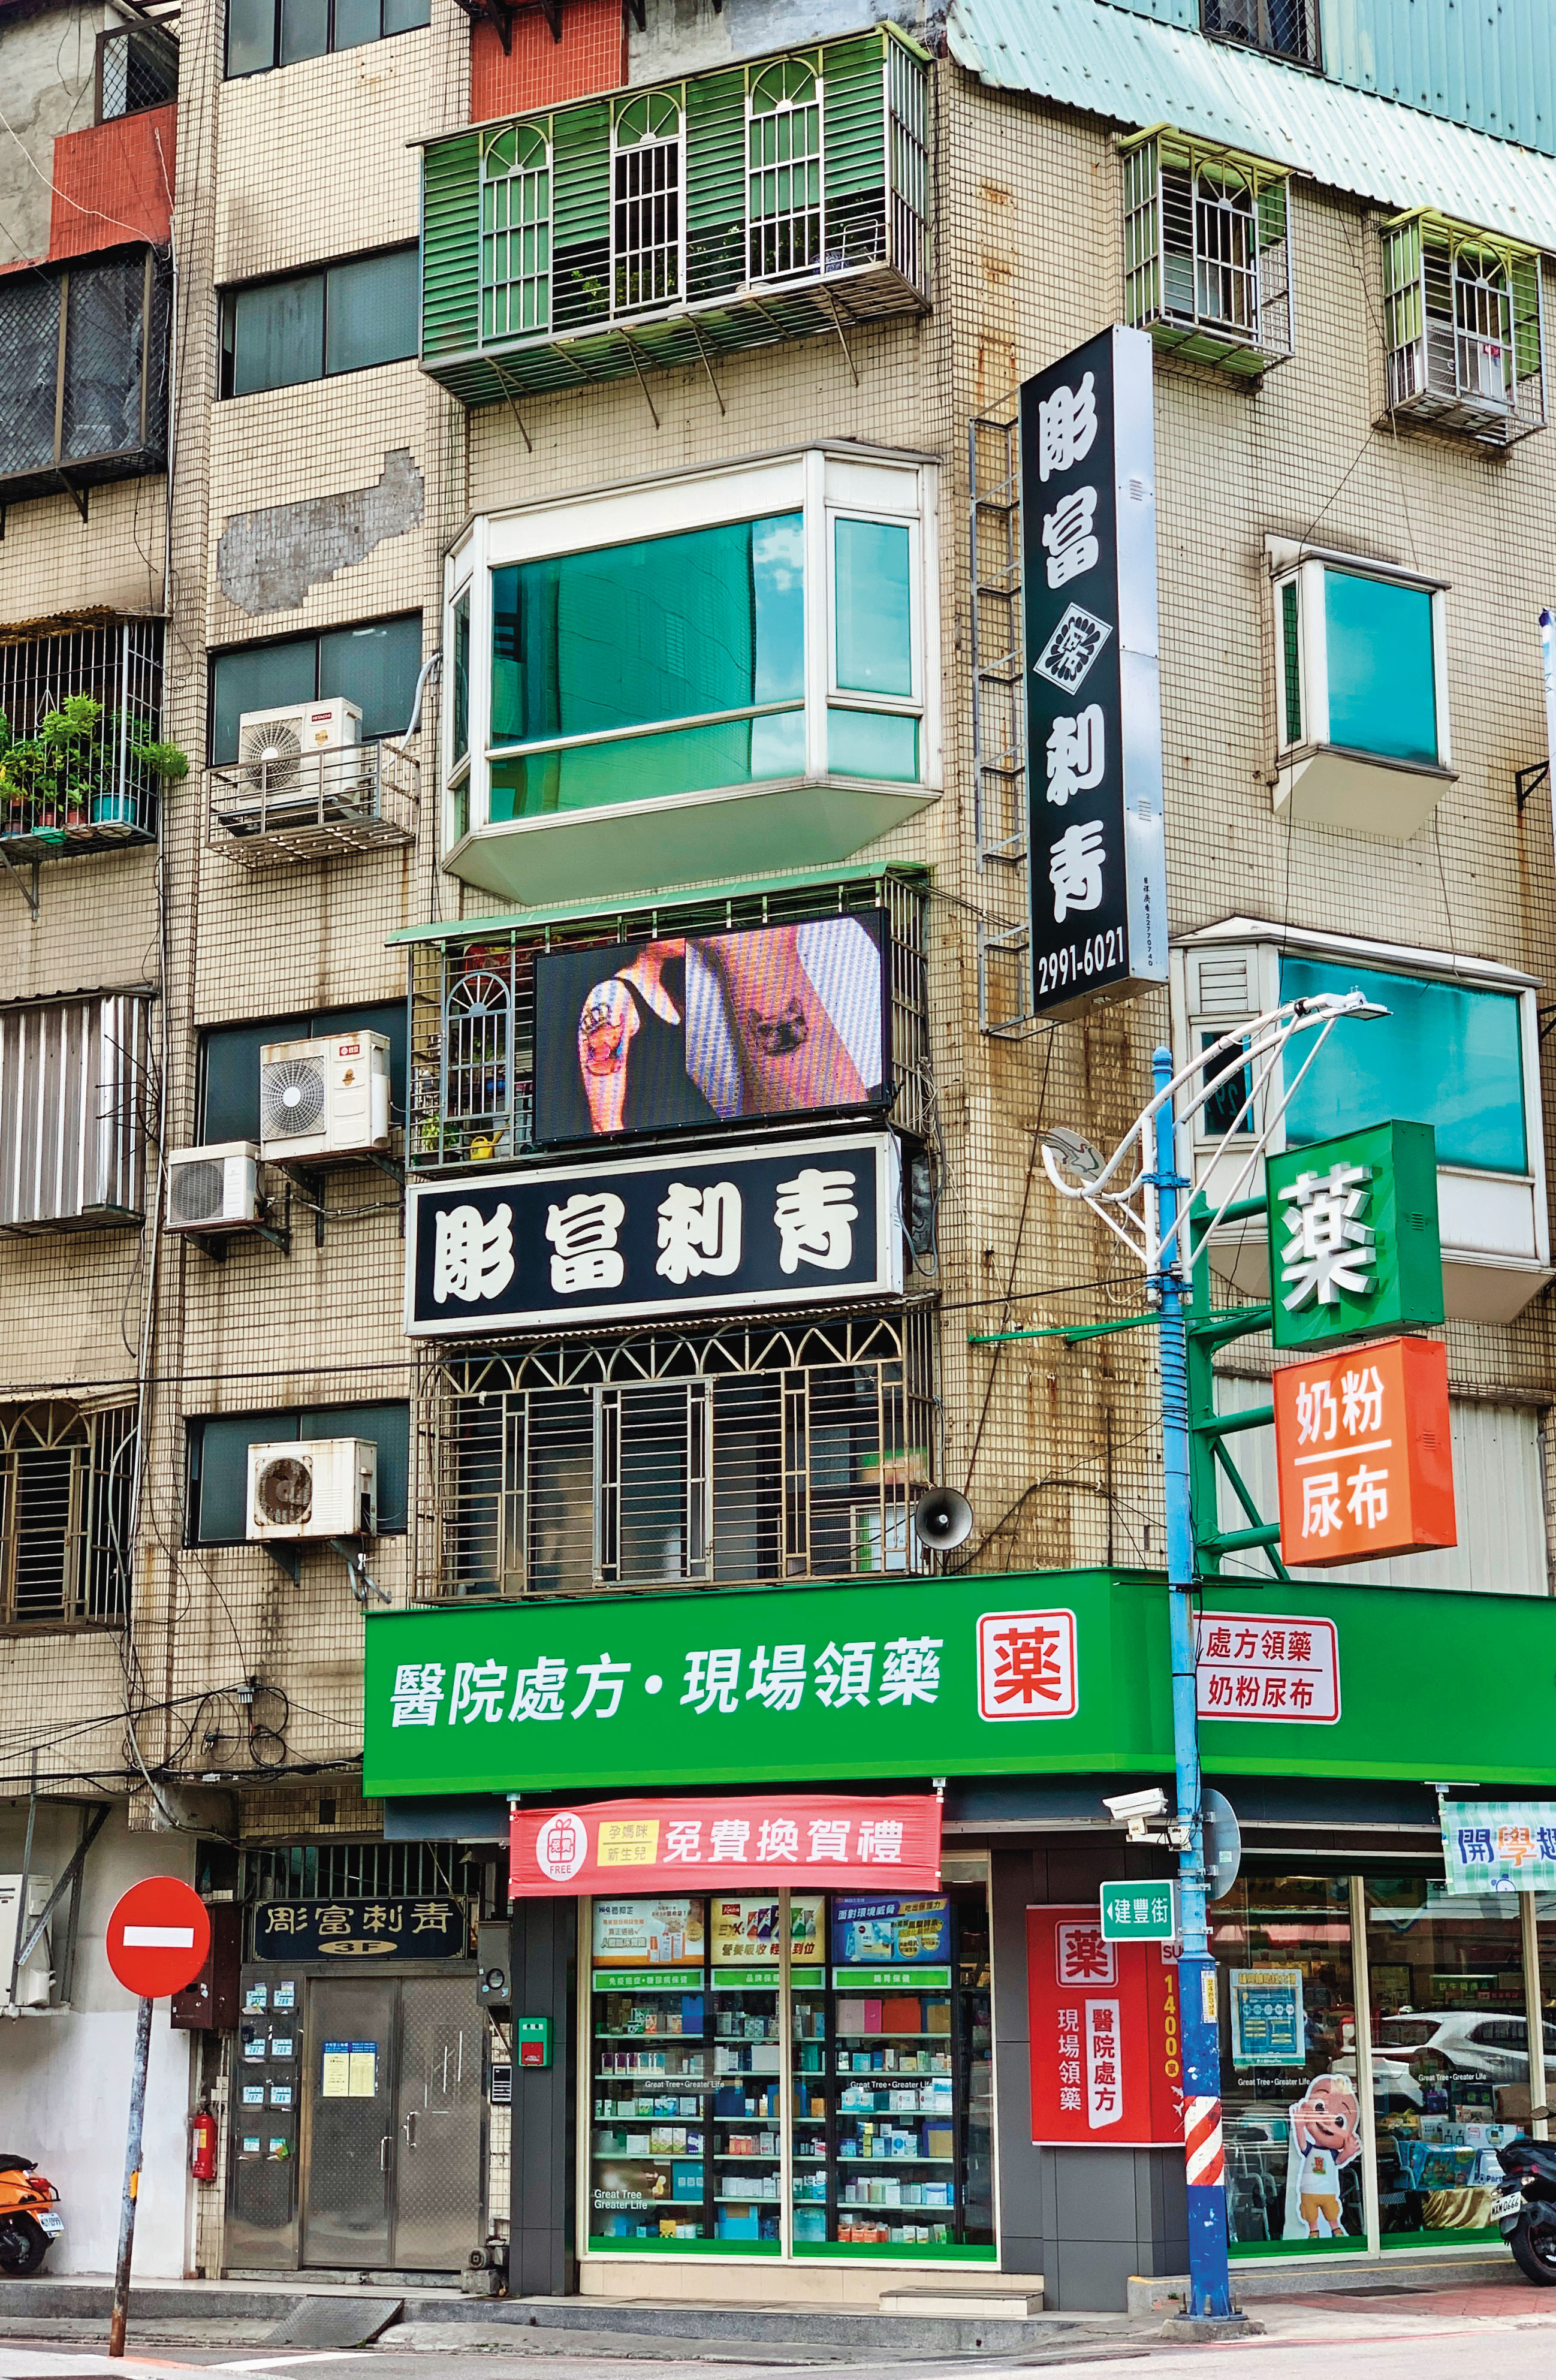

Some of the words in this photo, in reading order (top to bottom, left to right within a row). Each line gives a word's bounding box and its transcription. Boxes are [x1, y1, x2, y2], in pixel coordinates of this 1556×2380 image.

[1038, 926, 1124, 994] 2991-6021
[1295, 1365, 1385, 1446] 奶粉
[1301, 1468, 1389, 1539] 尿布
[1205, 1626, 1313, 1662] 處方領藥
[1207, 1674, 1315, 1709] 奶粉尿布
[609, 1824, 649, 1839] 孕媽咪
[663, 1817, 904, 1863] 免費換賀禮
[607, 1847, 647, 1862] 新生兒
[550, 1866, 571, 1874] FREE
[904, 1901, 941, 1911] 吃出保護力
[1114, 1899, 1169, 1924] 建豐街
[334, 1943, 381, 1953] 3F
[770, 1942, 815, 1956] 輕到位
[1163, 1945, 1183, 1958] SU
[1163, 1975, 1177, 2056] 1400
[1057, 2009, 1081, 2111] 現場領藥
[1091, 2009, 1116, 2111] 醫院處方
[594, 2189, 620, 2199] Great
[622, 2189, 642, 2199] Tree
[594, 2199, 628, 2209] Greater
[631, 2200, 647, 2210] Life
